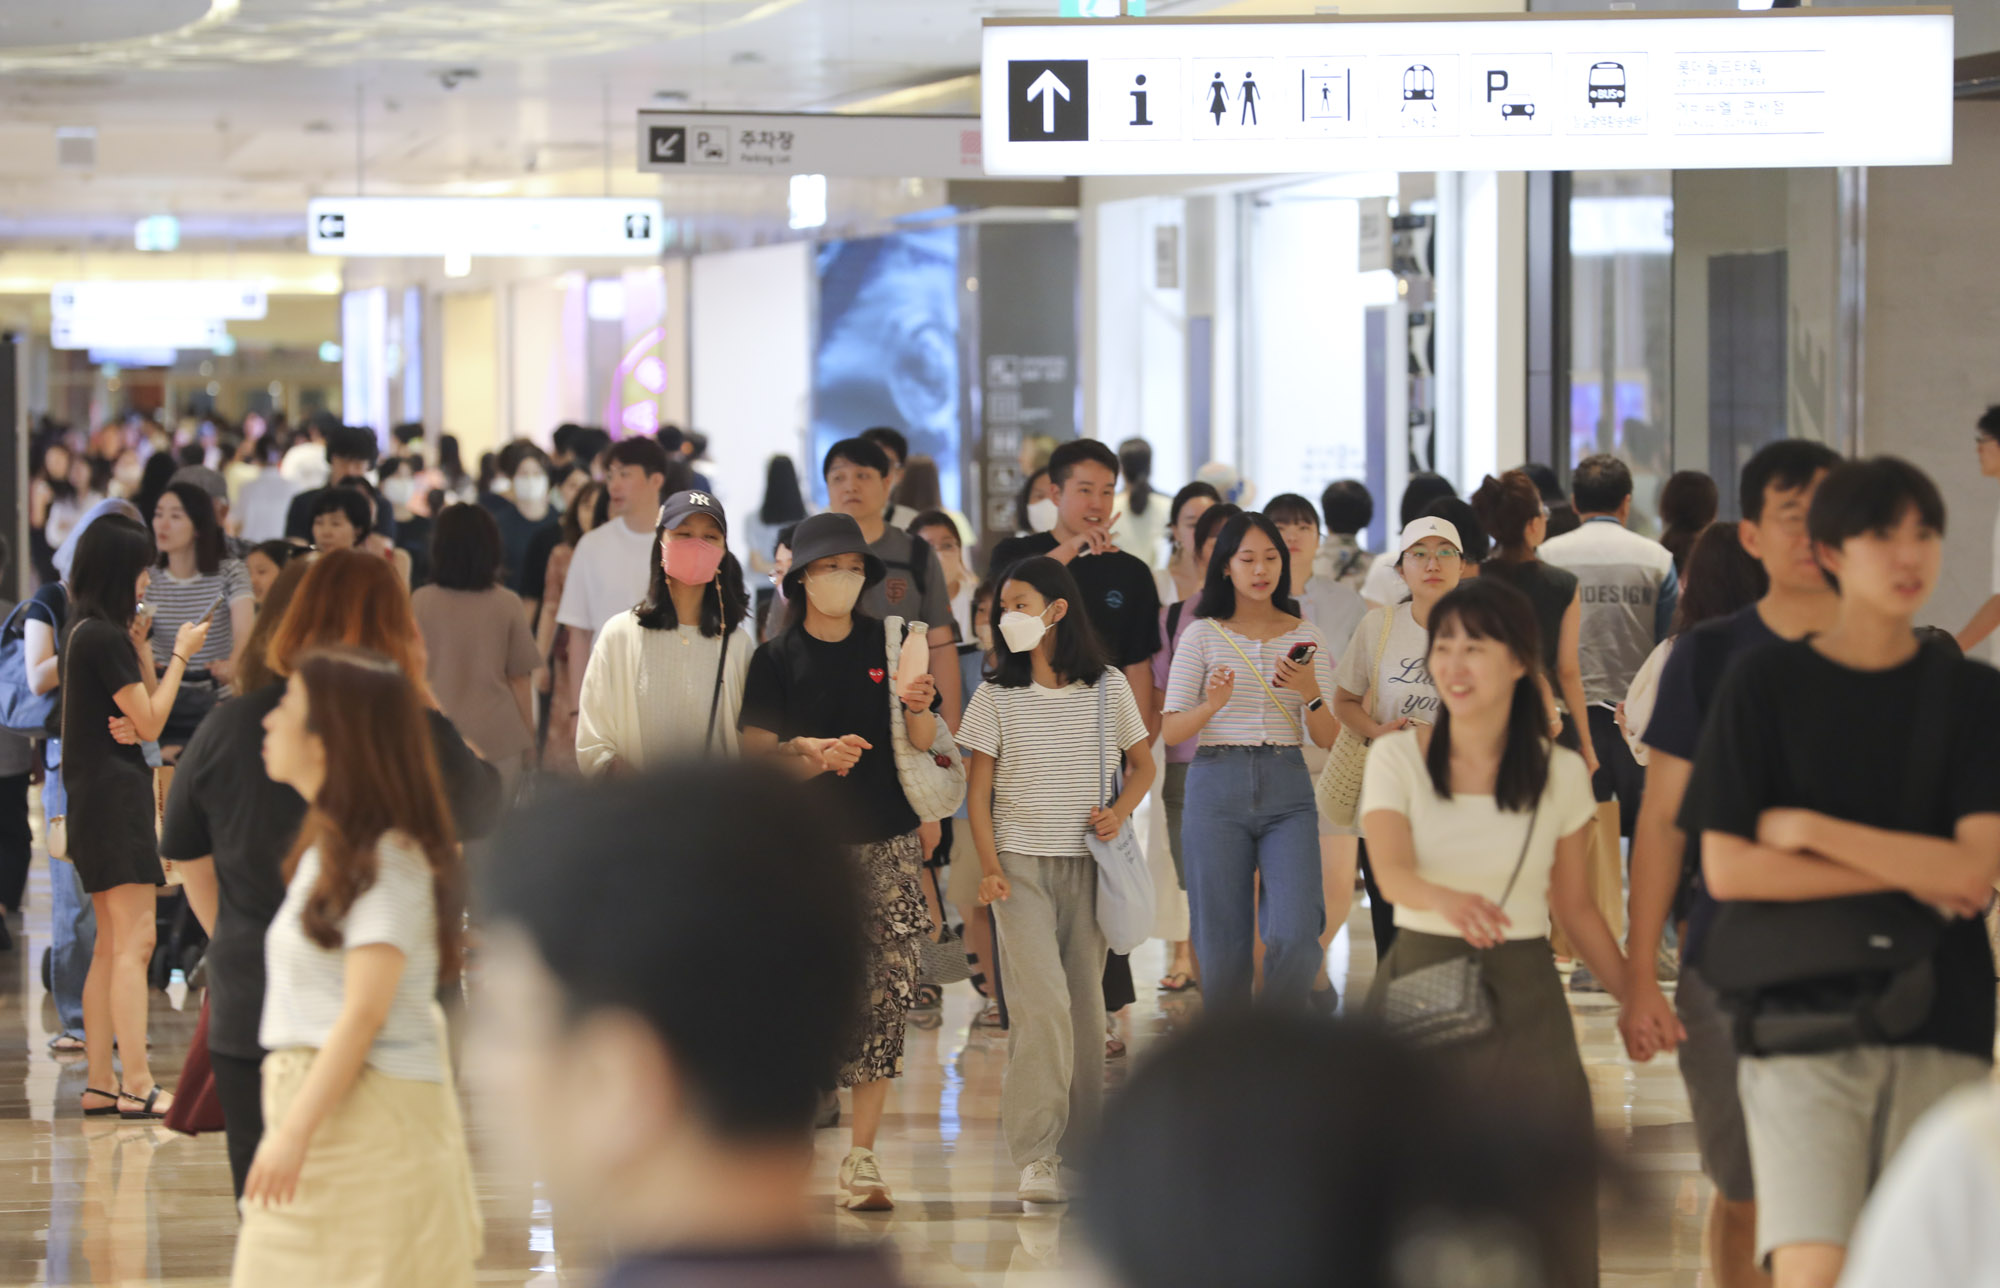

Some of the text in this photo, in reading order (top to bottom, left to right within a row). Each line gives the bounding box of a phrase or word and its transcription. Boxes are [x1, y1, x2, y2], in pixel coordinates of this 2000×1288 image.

[1487, 70, 1508, 103] P
[1597, 89, 1618, 99] BUS
[740, 130, 794, 151] 주차장
